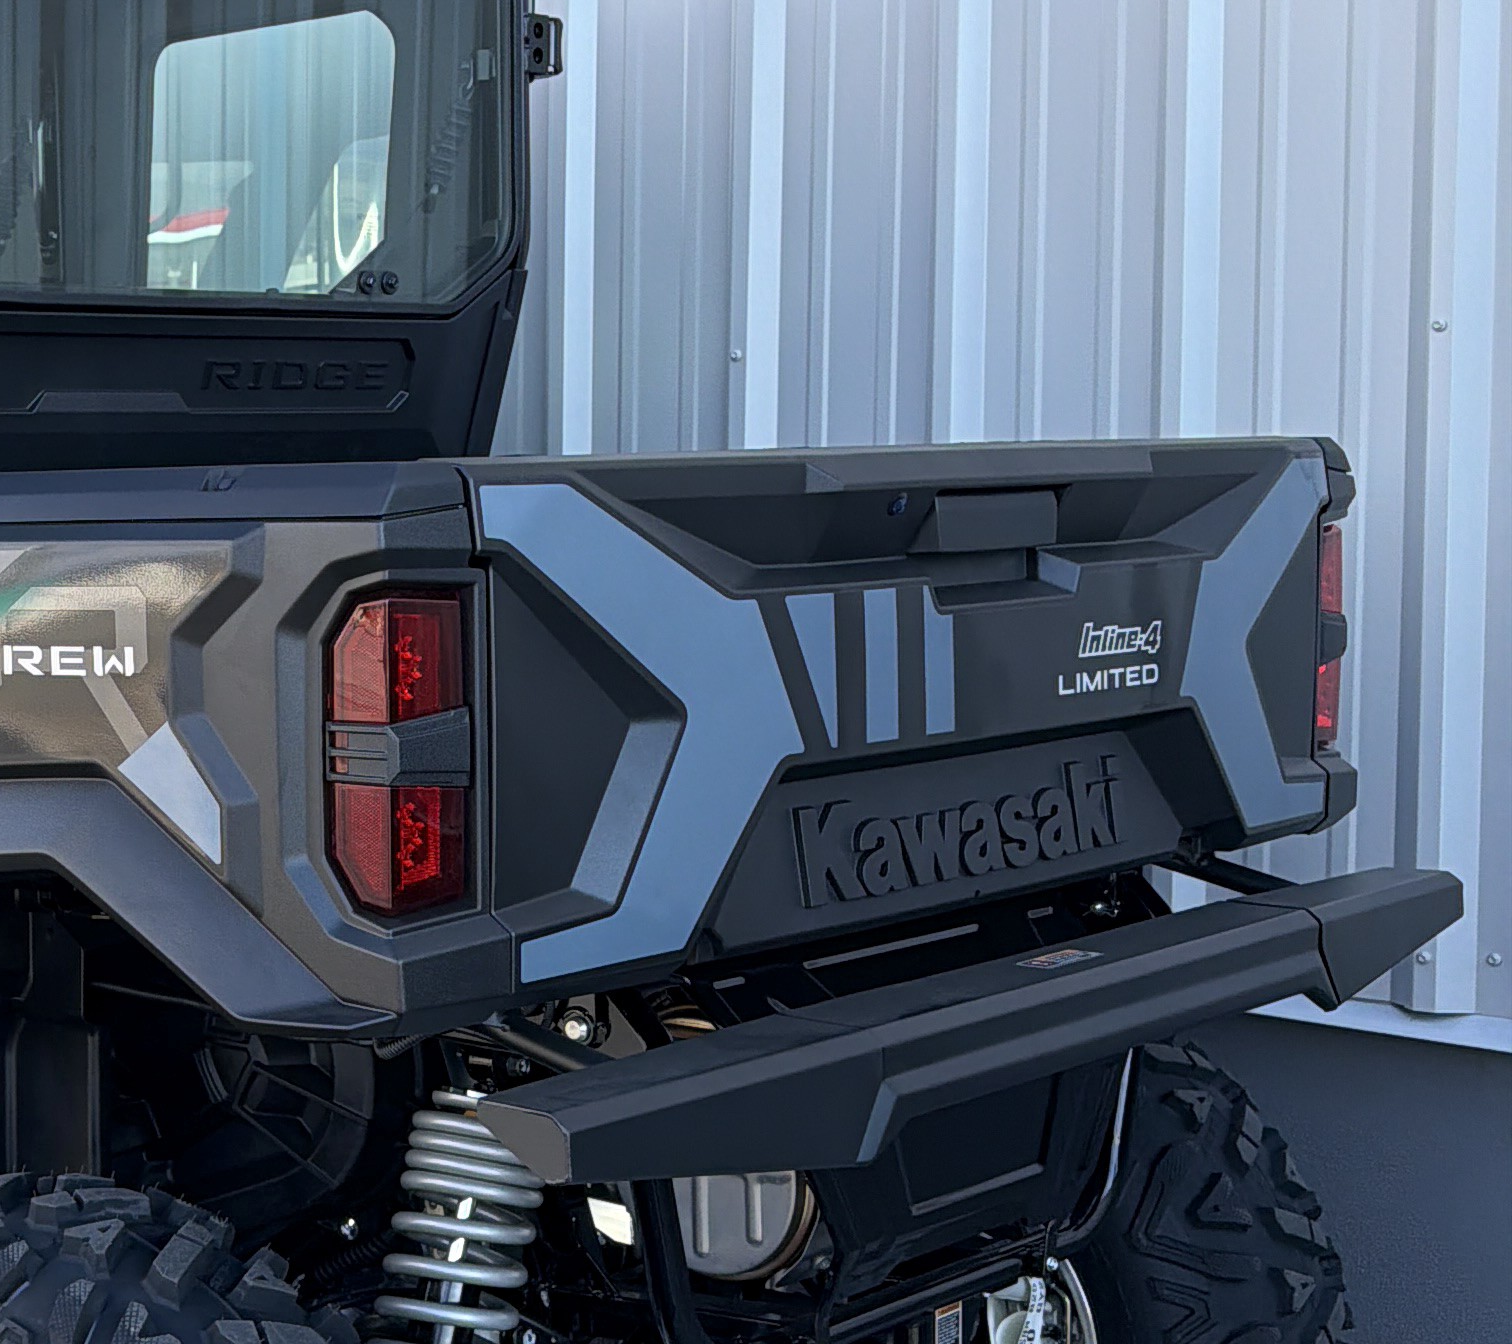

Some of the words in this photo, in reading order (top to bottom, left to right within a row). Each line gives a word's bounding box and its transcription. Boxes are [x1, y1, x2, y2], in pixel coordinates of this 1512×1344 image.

[201, 360, 388, 390] RIDGE
[1078, 620, 1162, 658] Inline-4
[1058, 663, 1159, 695] LIMITED
[791, 754, 1124, 909] Kawasaki
